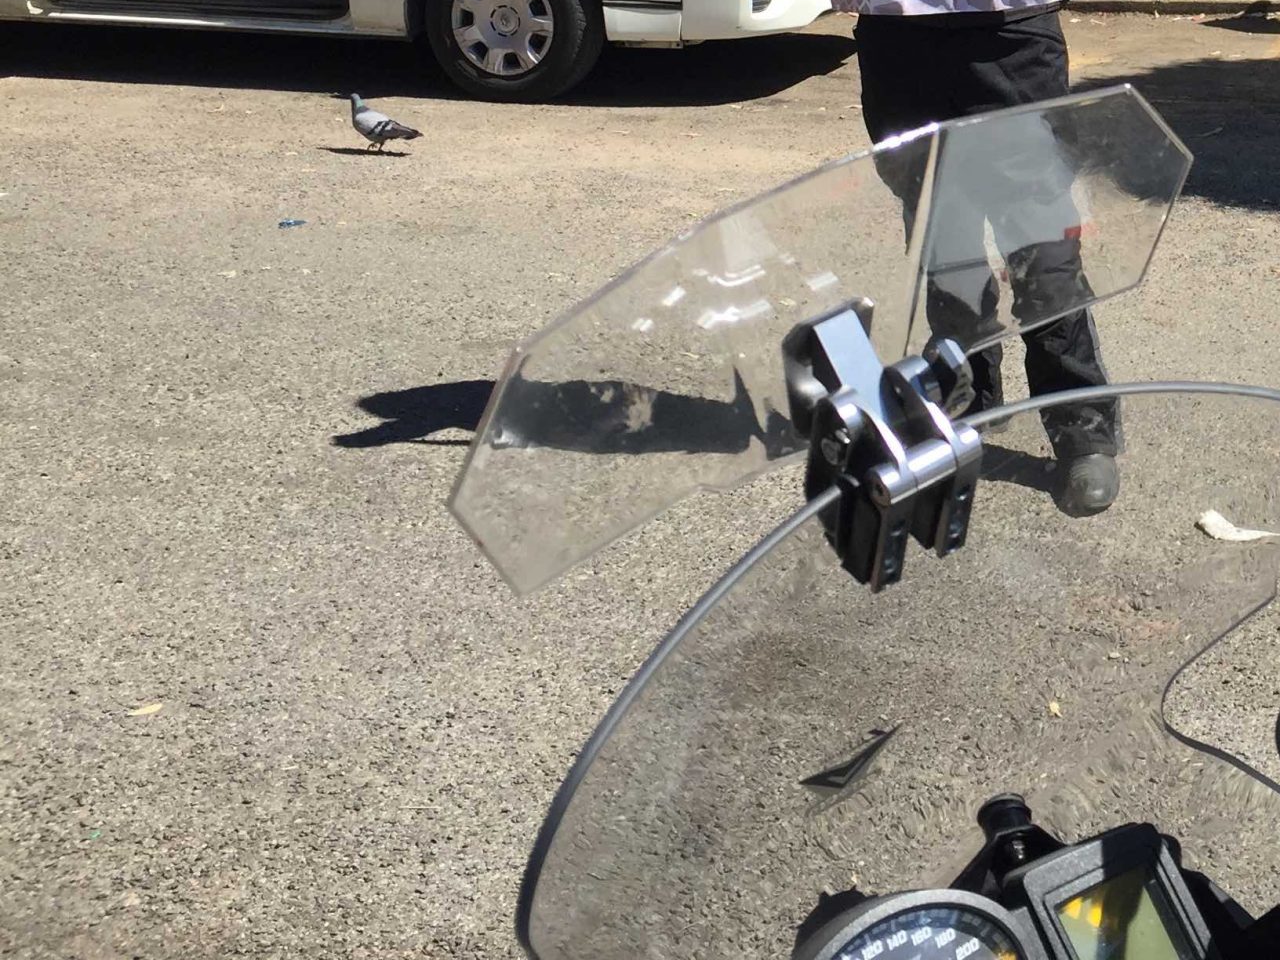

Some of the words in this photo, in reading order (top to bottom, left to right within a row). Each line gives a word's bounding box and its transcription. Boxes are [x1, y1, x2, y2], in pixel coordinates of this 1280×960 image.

[886, 930, 908, 951] 140
[910, 926, 932, 946] 160
[934, 928, 956, 949] 180
[861, 939, 884, 960] 120
[955, 937, 980, 960] 200
